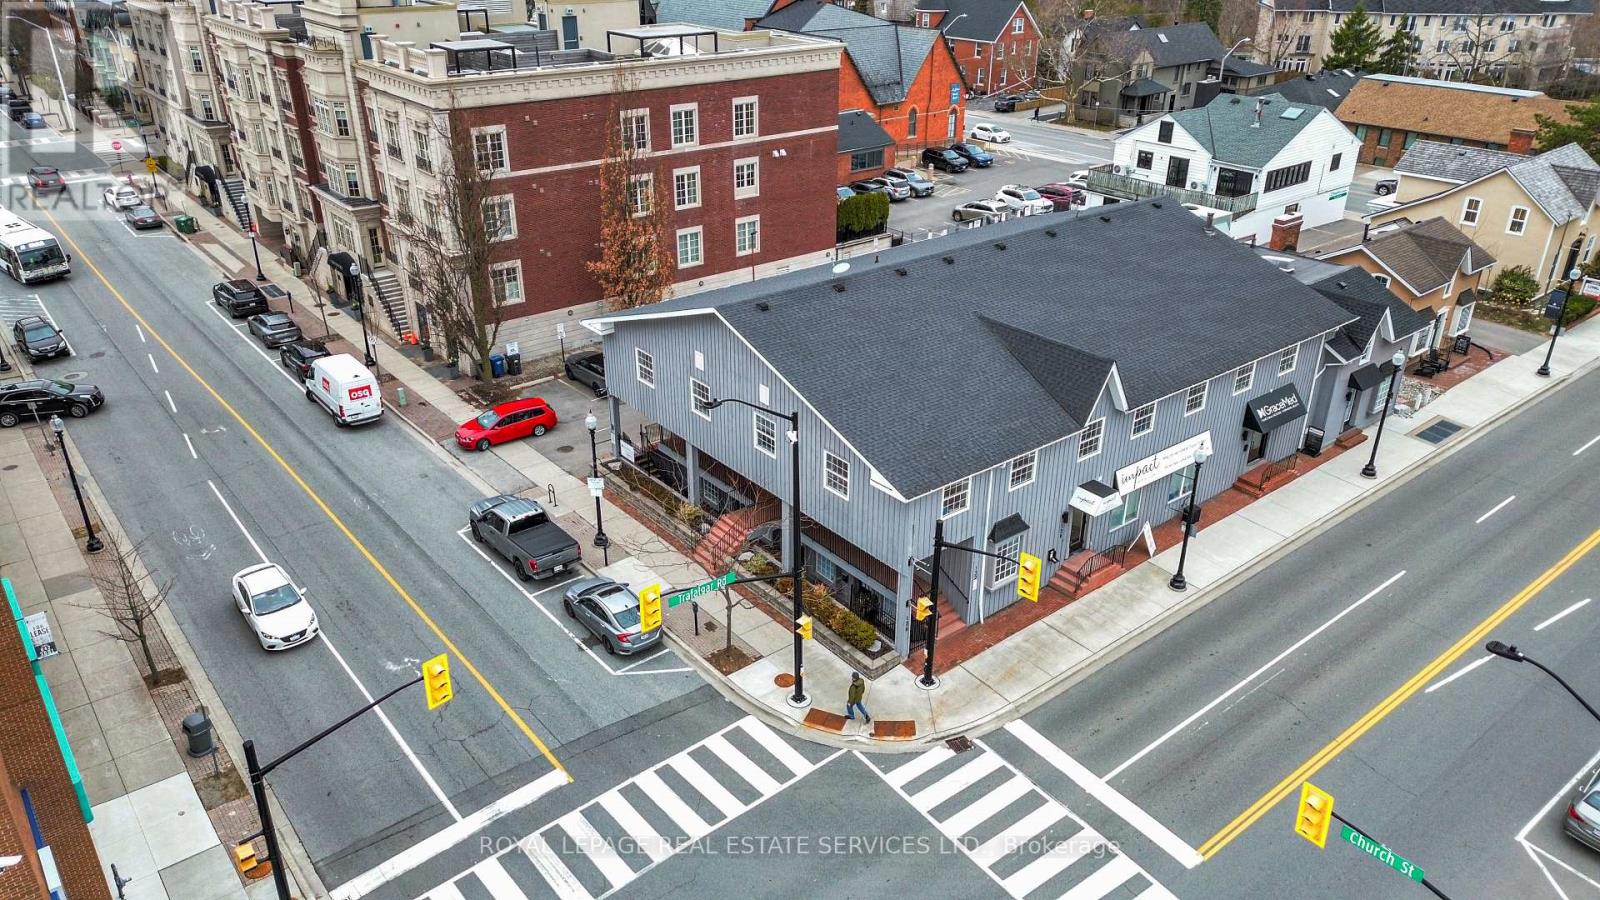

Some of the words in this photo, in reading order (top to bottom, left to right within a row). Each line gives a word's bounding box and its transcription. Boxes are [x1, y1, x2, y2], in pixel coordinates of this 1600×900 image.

[1263, 393, 1298, 415] GraceMed
[1121, 455, 1160, 489] impact
[678, 583, 713, 603] Trafalgar
[717, 575, 727, 588] Rd
[1350, 832, 1395, 866] Church
[1401, 861, 1415, 877] St
